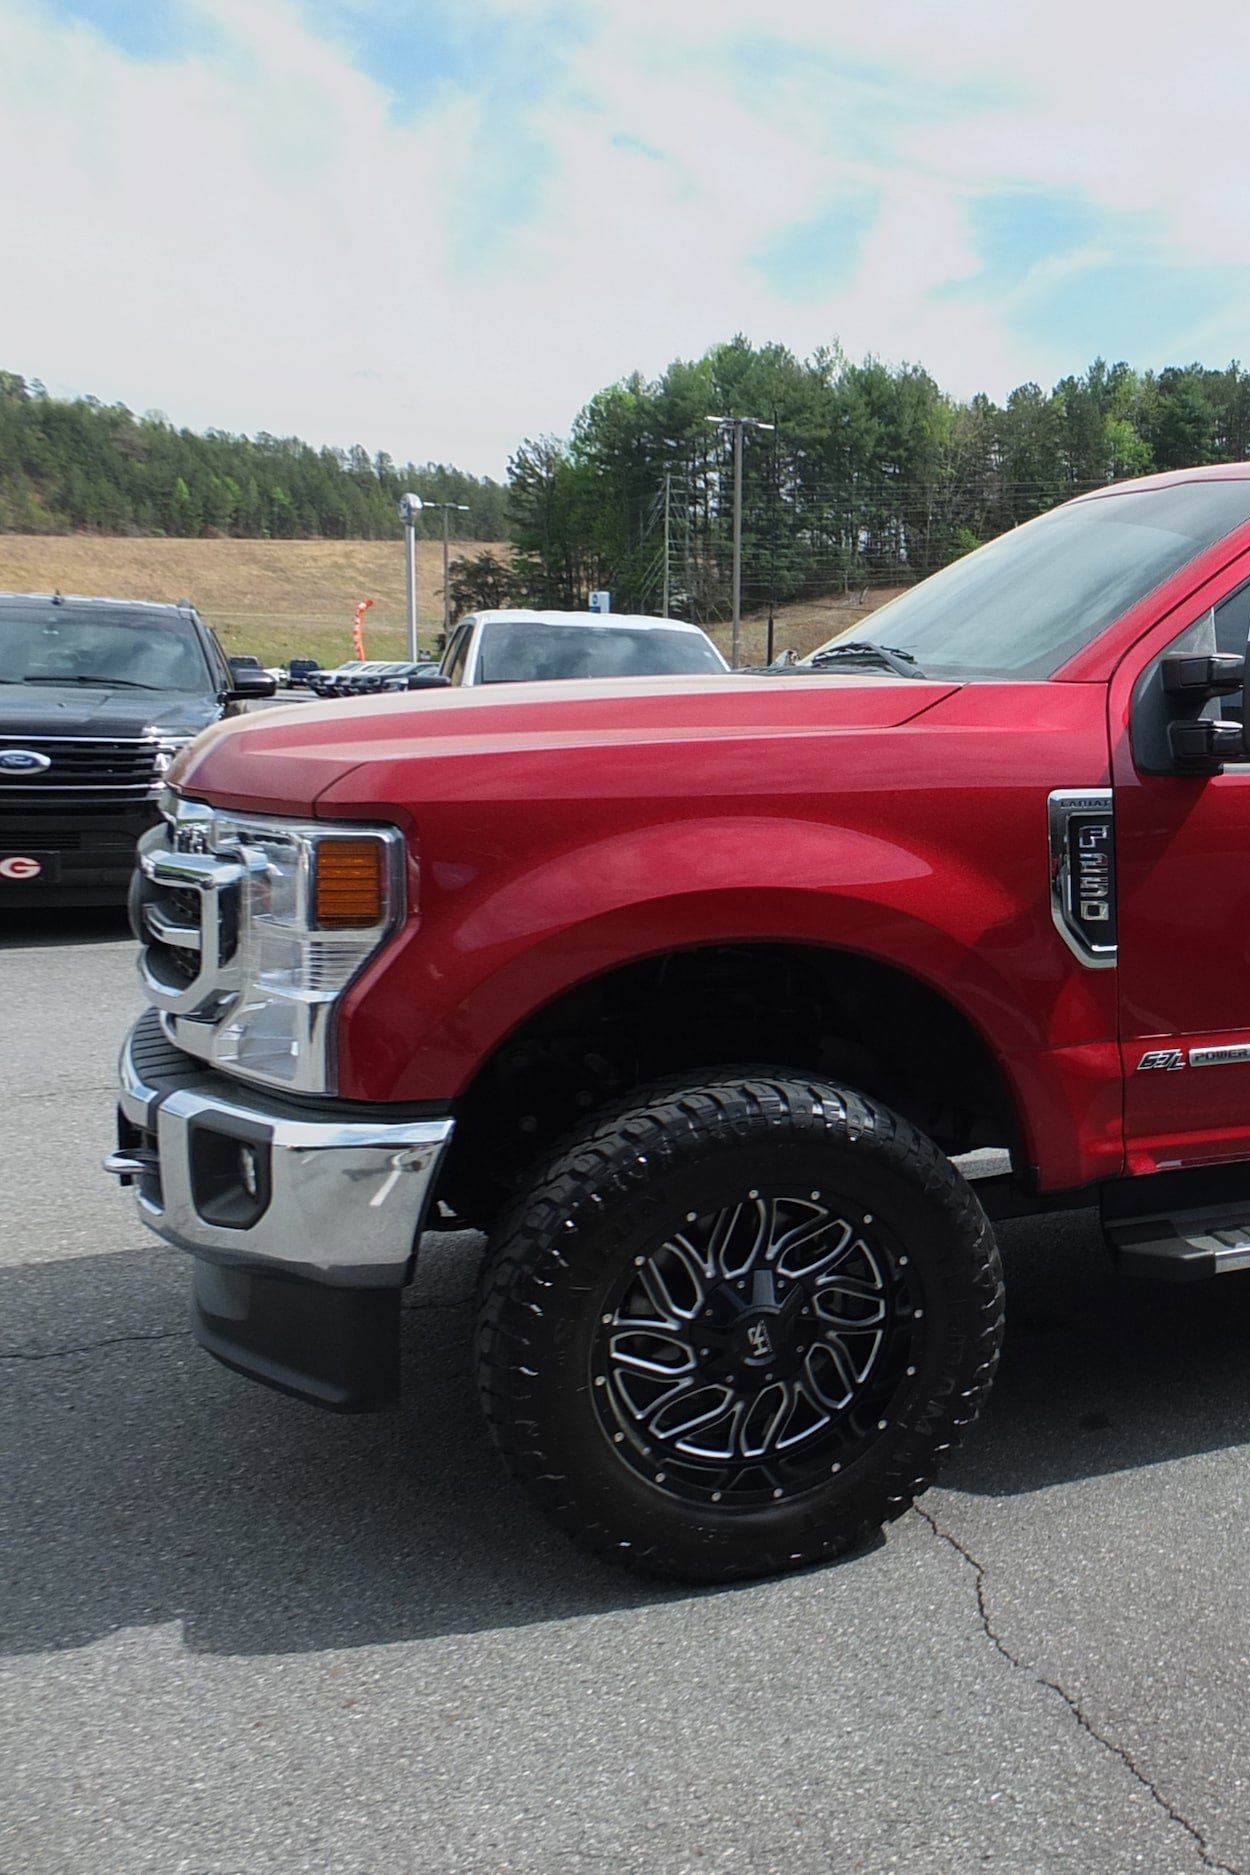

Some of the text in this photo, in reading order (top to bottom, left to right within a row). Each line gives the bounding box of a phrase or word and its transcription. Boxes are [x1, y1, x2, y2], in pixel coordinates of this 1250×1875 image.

[1060, 799, 1111, 809] LARIAT
[0, 857, 41, 878] G
[1194, 1049, 1248, 1062] POWER
